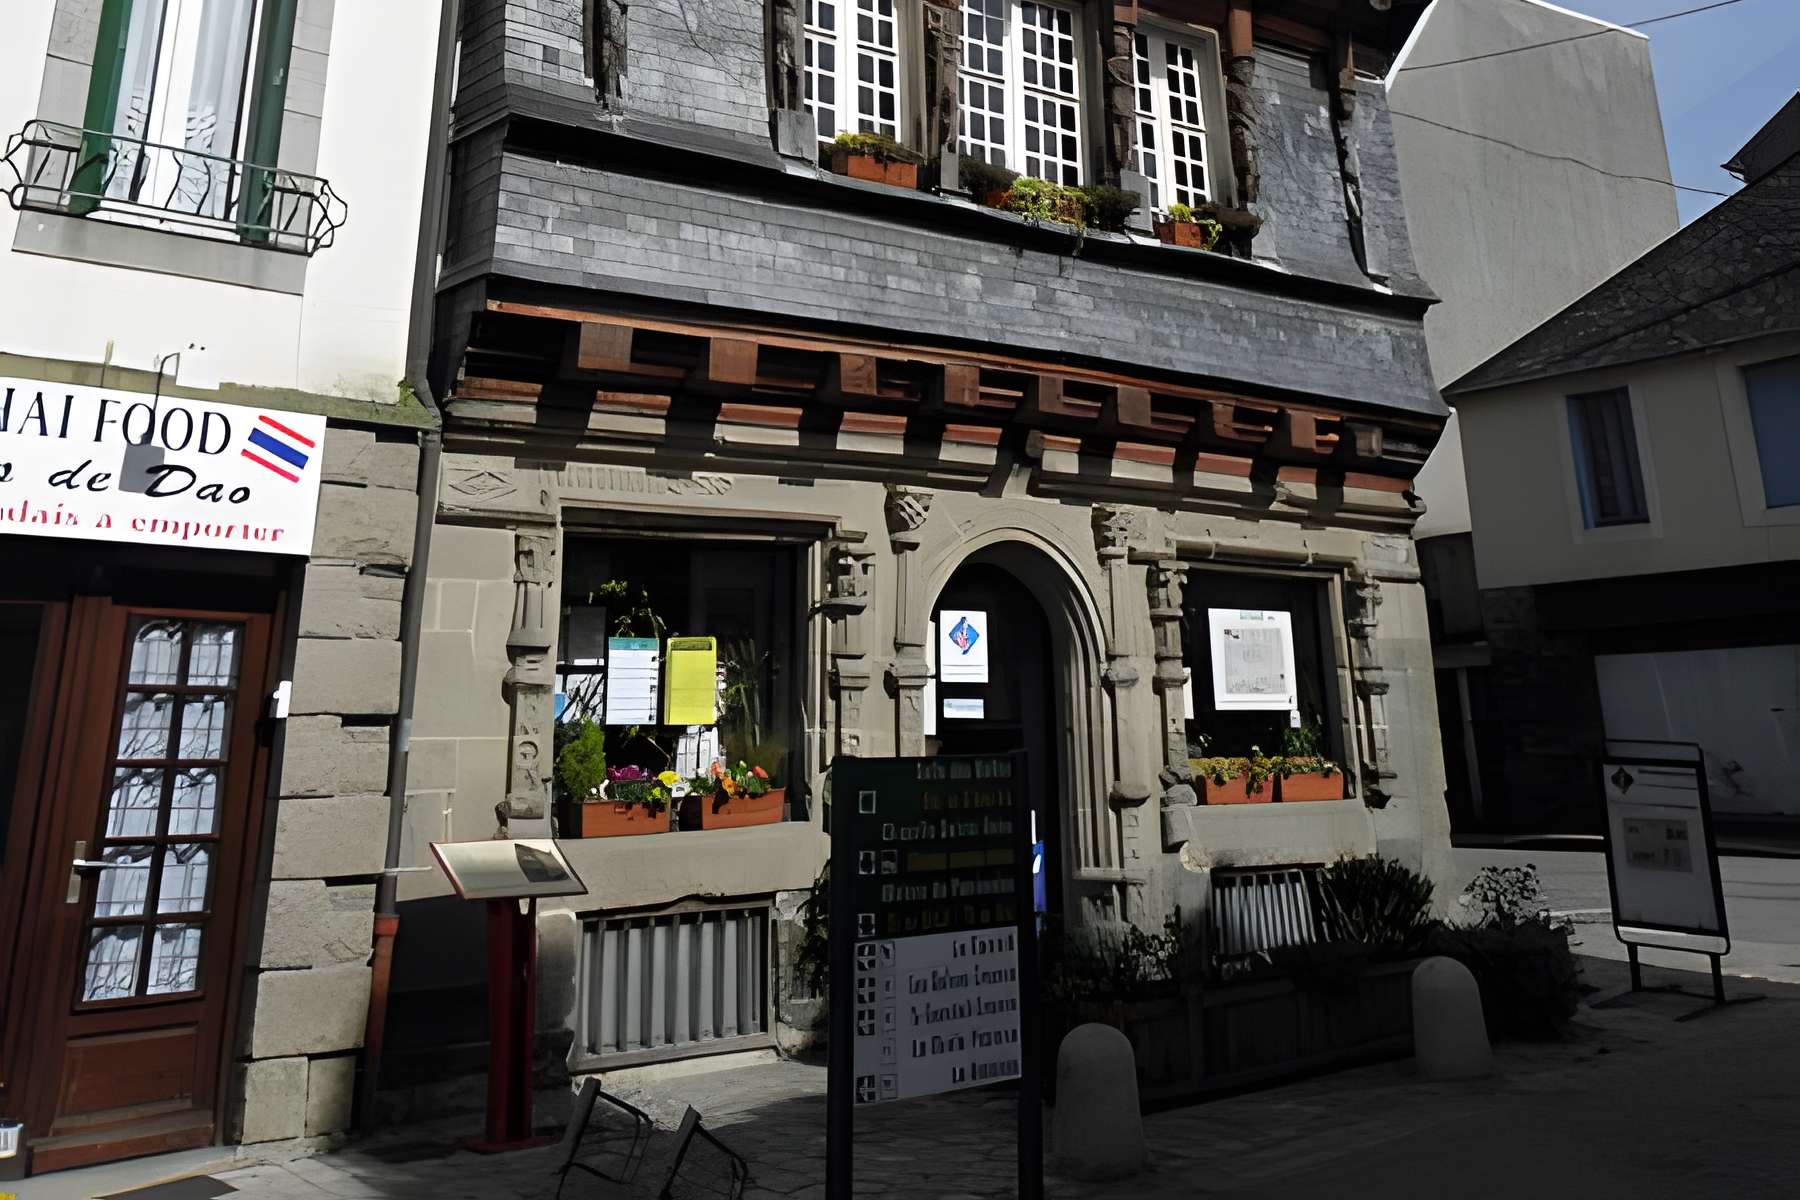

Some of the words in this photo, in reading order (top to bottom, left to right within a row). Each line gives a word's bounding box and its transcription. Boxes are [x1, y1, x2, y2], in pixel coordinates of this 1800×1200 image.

[94, 399, 231, 455] FOOD
[48, 459, 111, 492] de
[145, 464, 251, 504] Dao
